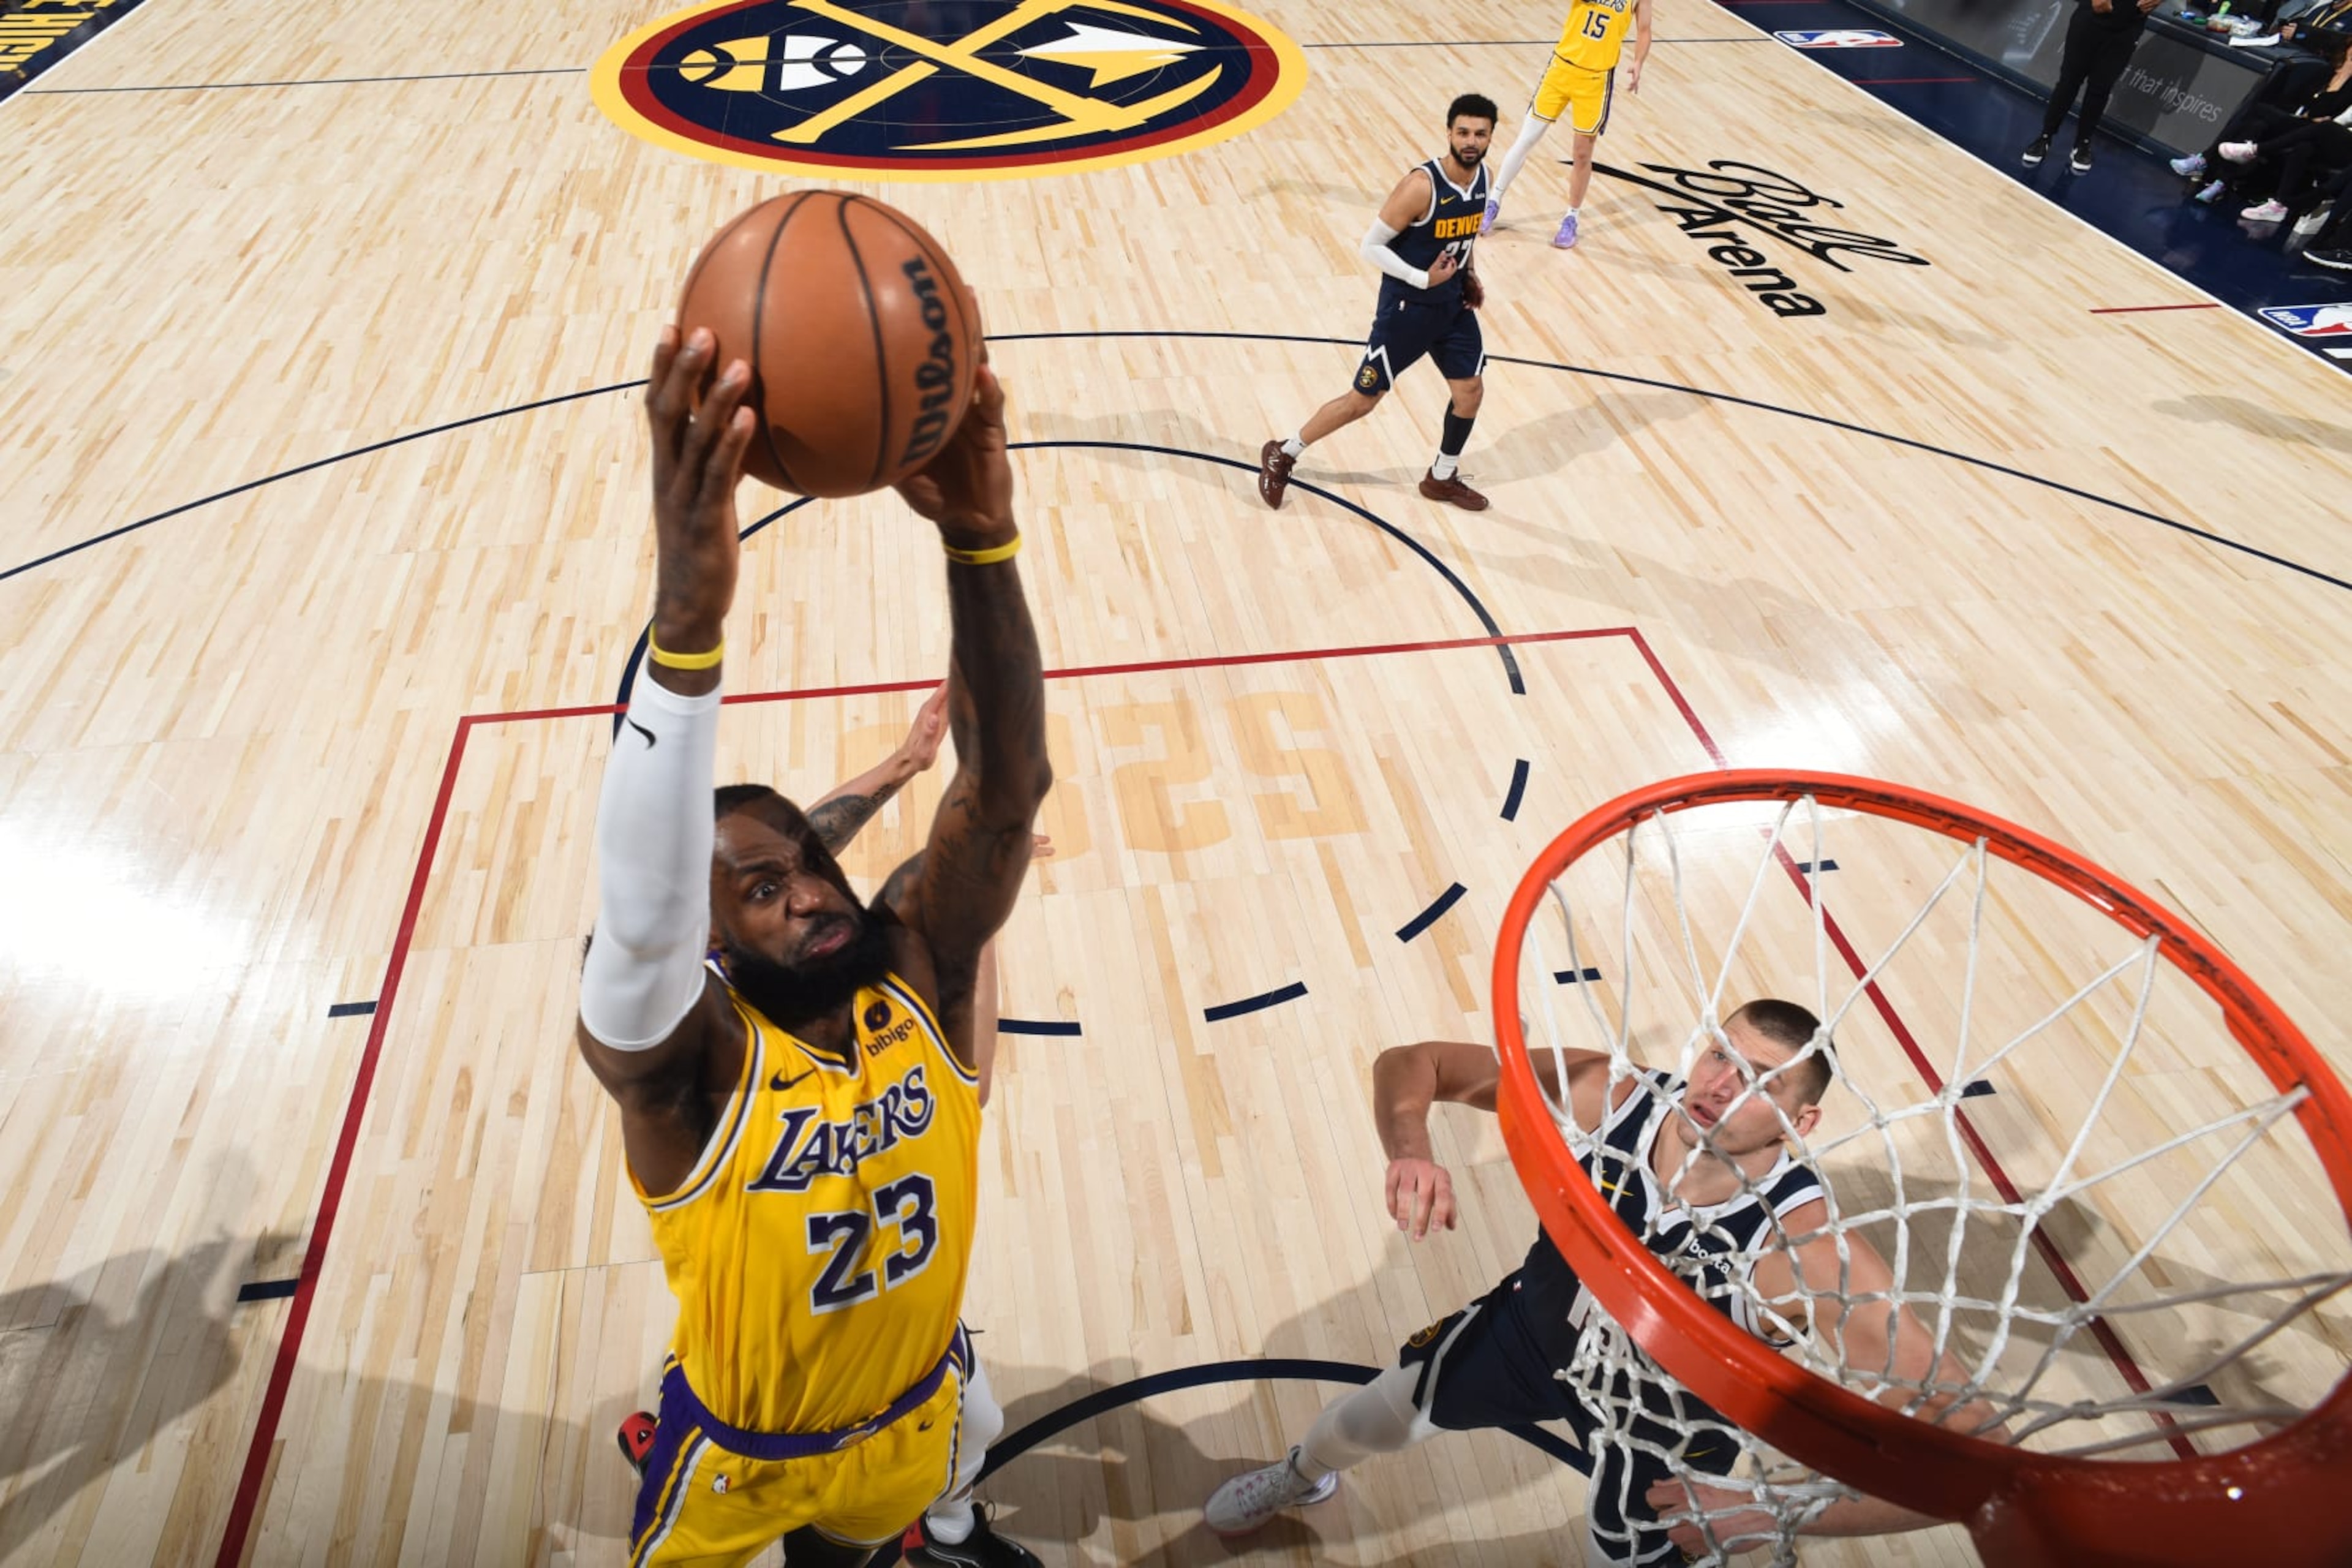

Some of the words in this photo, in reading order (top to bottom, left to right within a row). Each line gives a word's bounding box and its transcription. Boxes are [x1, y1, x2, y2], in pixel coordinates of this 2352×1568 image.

[1581, 10, 1610, 40] 15
[2128, 68, 2162, 94] that
[2160, 81, 2223, 123] inspires
[1656, 205, 1826, 317] Arena
[899, 255, 954, 467] Wilson
[865, 1018, 914, 1058] bibigo
[745, 1066, 935, 1193] LAKERS
[807, 1174, 937, 1315] 23
